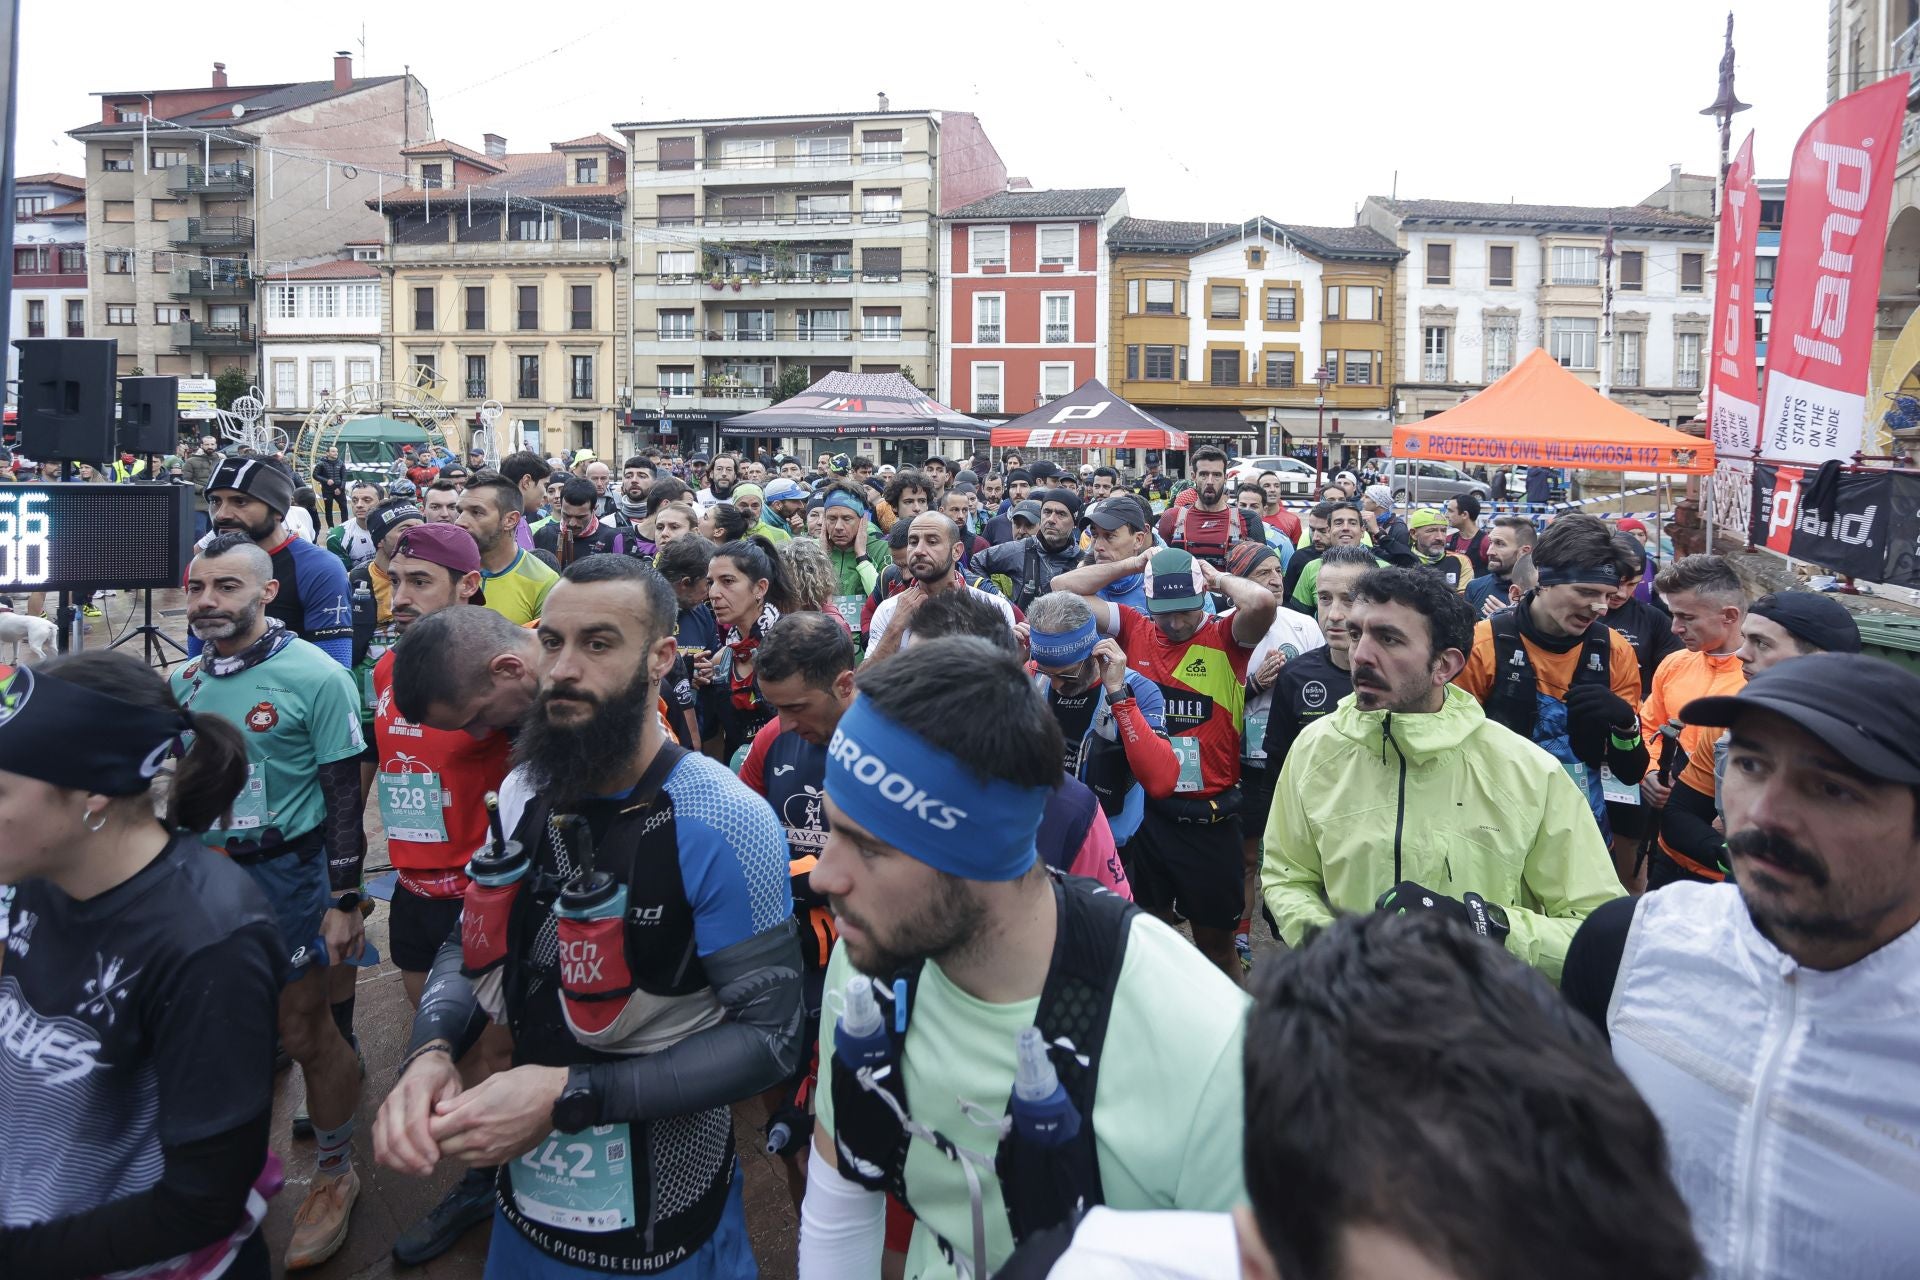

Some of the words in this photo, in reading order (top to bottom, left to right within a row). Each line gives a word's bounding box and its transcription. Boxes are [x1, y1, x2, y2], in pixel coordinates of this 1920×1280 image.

[1792, 398, 1808, 445] STARTS
[1810, 403, 1825, 427] THE
[1825, 407, 1840, 448] INSIDE
[1055, 430, 1129, 445] land
[1808, 429, 1820, 448] ON
[1428, 435, 1508, 459] PROTECCION
[1510, 439, 1542, 461] CIVIL
[1544, 440, 1634, 465] VILLAVICIOSA
[1636, 447, 1660, 467] 112
[837, 602, 857, 615] 65
[1056, 696, 1088, 705] land
[1164, 699, 1202, 716] RNER
[828, 728, 968, 830] BROOKS
[387, 787, 426, 810] 328
[787, 831, 829, 845] AYAD
[630, 904, 664, 920] nd
[559, 940, 597, 959] RCh
[521, 1140, 596, 1178] 242
[535, 1170, 578, 1187] MUFASA
[553, 1240, 596, 1265] PICOS
[599, 1256, 621, 1269] DE
[622, 1246, 687, 1271] EUROPA
